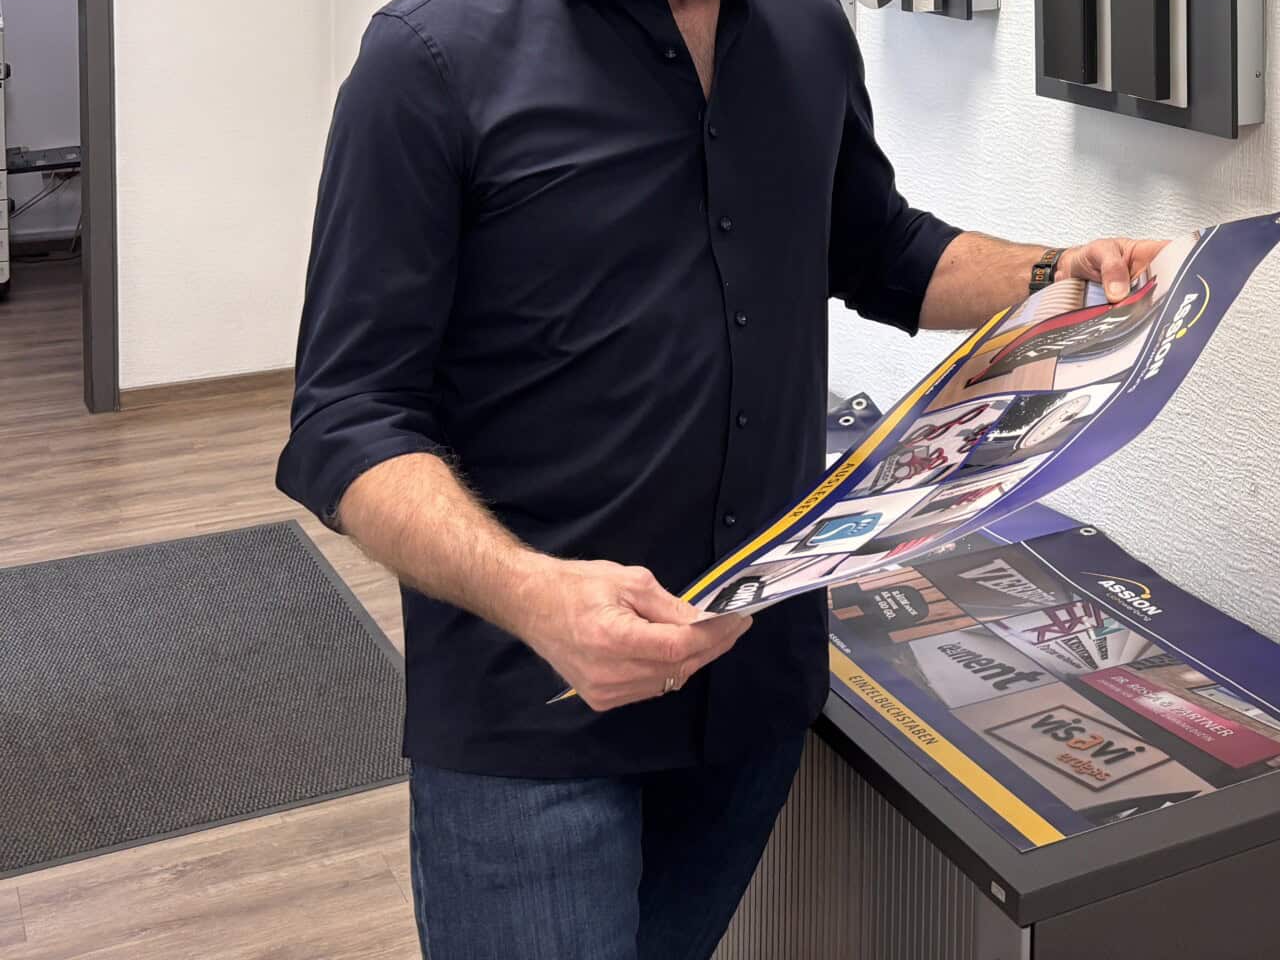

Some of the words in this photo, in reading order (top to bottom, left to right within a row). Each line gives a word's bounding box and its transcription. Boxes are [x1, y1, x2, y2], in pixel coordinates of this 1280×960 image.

[1143, 292, 1200, 380] ASSION
[1097, 580, 1163, 616] ASSION
[848, 675, 938, 746] EINZELBUCHSTABEN
[1031, 714, 1146, 765] visavi
